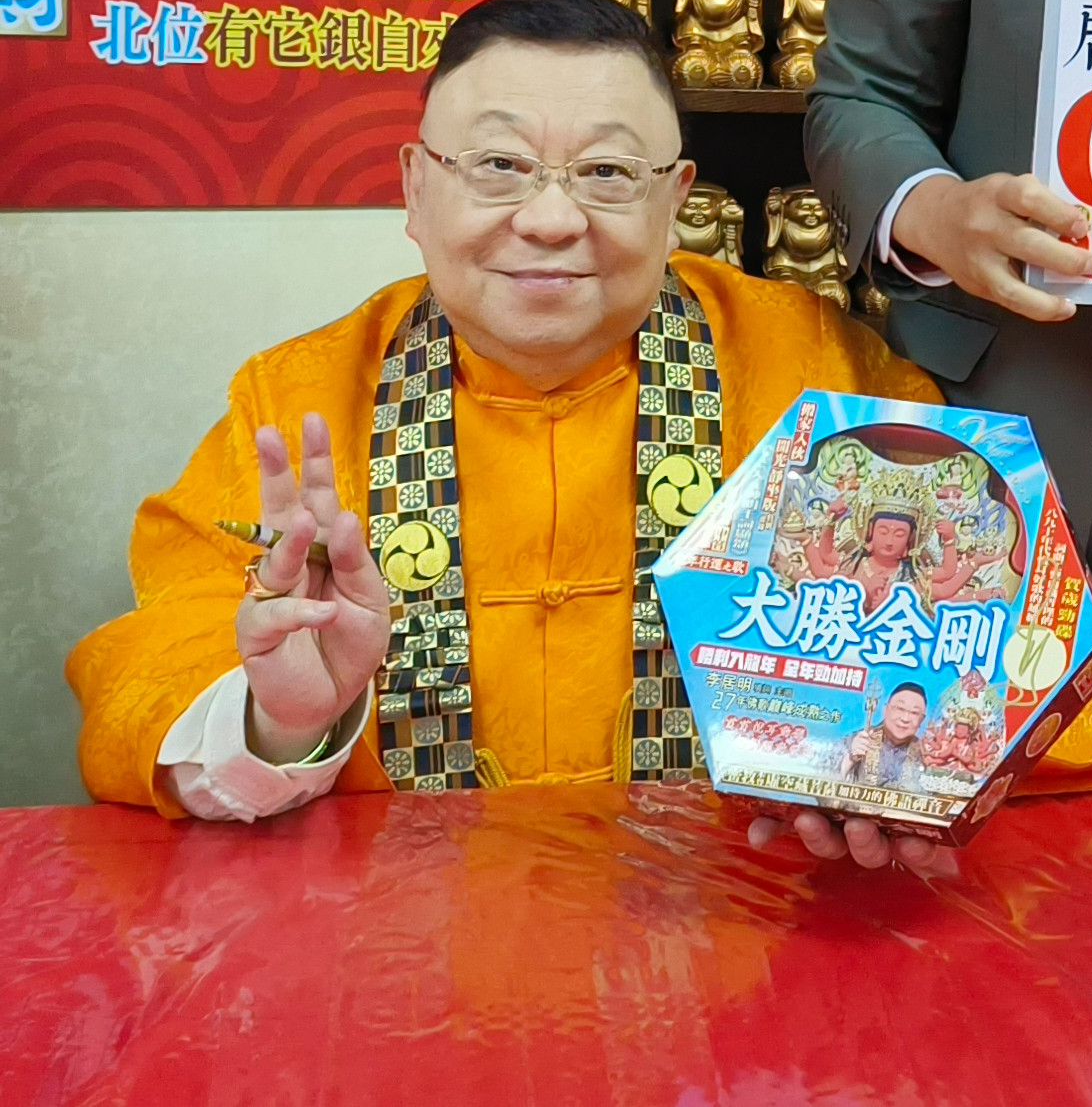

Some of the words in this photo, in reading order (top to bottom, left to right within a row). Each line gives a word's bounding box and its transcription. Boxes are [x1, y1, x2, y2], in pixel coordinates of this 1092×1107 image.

[718, 572, 1006, 678] 大勝金剛
[706, 671, 752, 692] 李居明
